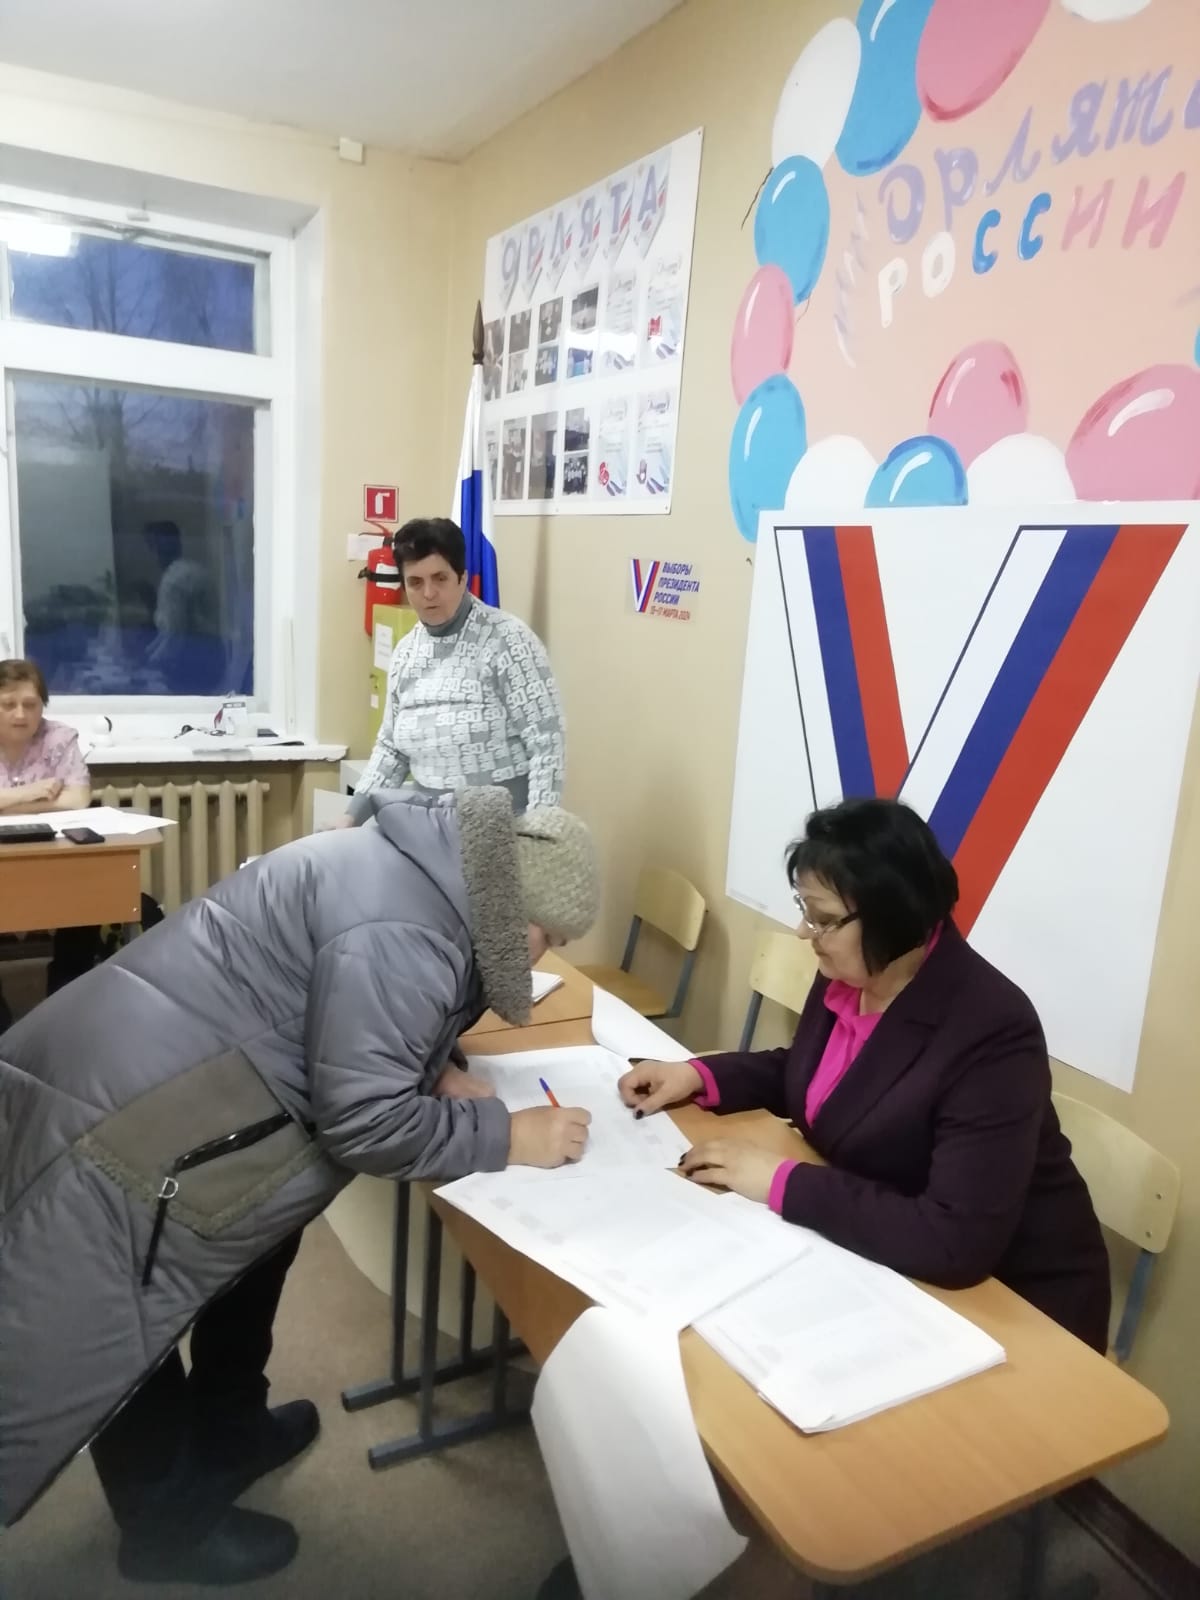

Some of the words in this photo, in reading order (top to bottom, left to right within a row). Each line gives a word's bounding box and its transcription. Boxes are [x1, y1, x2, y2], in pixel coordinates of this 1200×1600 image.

[662, 561, 693, 575] ВЫБОРЫ
[658, 577, 700, 592] ПРЕЗИДЕНТА
[653, 591, 680, 605] РОССИИ
